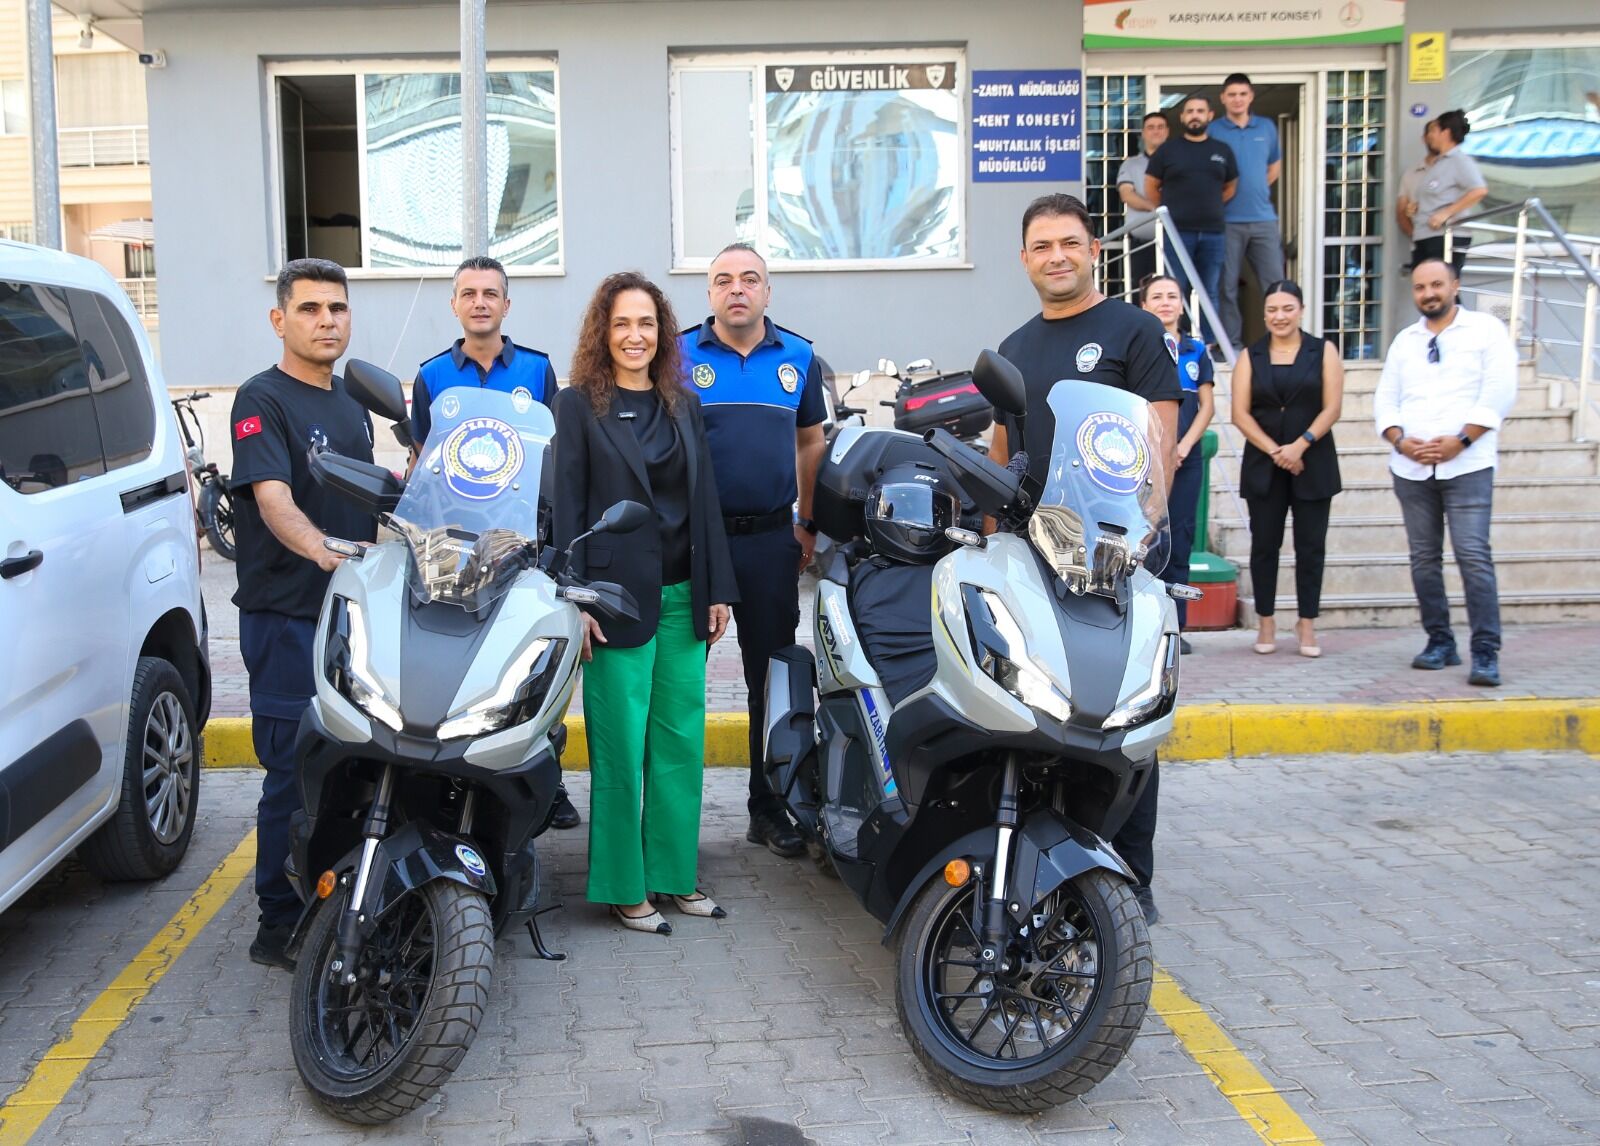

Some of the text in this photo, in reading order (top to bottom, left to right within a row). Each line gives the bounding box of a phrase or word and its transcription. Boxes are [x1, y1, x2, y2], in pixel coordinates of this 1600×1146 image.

[1168, 12, 1234, 24] KARŞIYAKA
[1236, 11, 1268, 22] KENT
[1270, 8, 1322, 22] KONSEYİ
[810, 64, 910, 90] GÜVENLİK
[1019, 79, 1080, 97] MÜDÜRLÜĞÜ
[1016, 108, 1076, 127] KONSEYİ
[1044, 134, 1081, 155] İŞLERİ
[978, 156, 1047, 173] MÜDÜRLÜĞÜ
[467, 420, 512, 439] ZABITA
[442, 543, 476, 556] HONDA
[1095, 536, 1127, 549] HONDA
